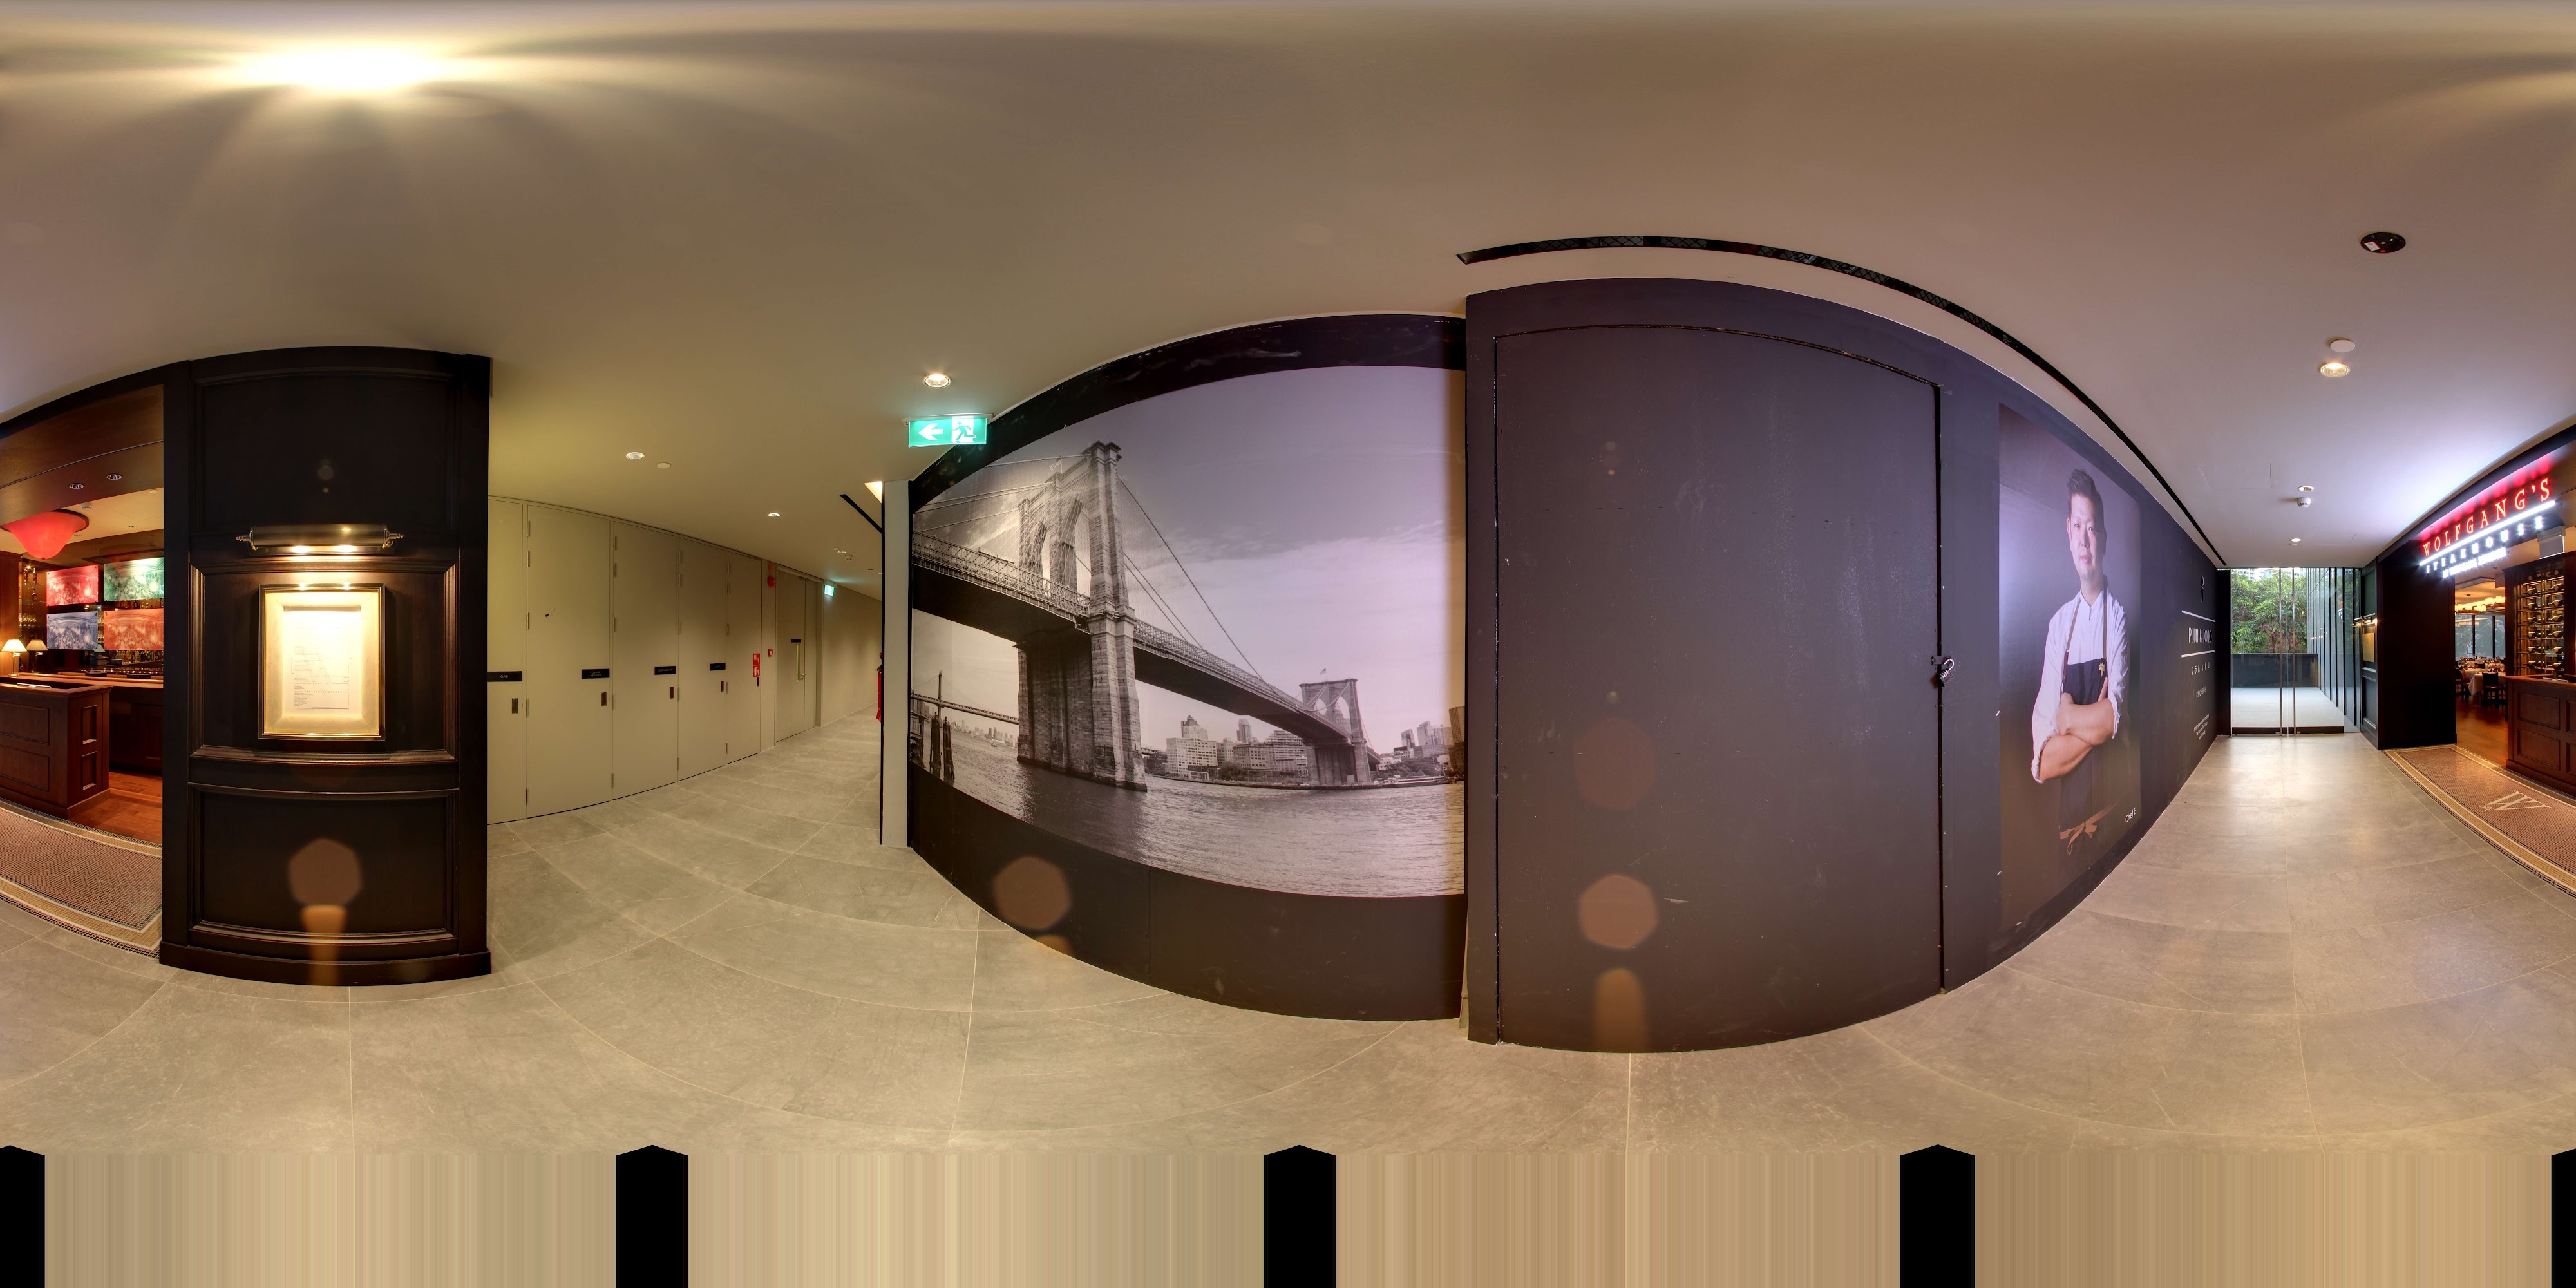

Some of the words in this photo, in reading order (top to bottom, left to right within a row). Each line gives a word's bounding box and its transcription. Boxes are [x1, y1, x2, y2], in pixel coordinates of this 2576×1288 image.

[2423, 478, 2550, 557] WOLFGANG'S
[2426, 516, 2543, 574] STEAKHOUSE
[2188, 627, 2199, 643] PLUM
[2199, 629, 2202, 643] &
[2125, 809, 2134, 823] Chef
[2133, 807, 2136, 815] E
